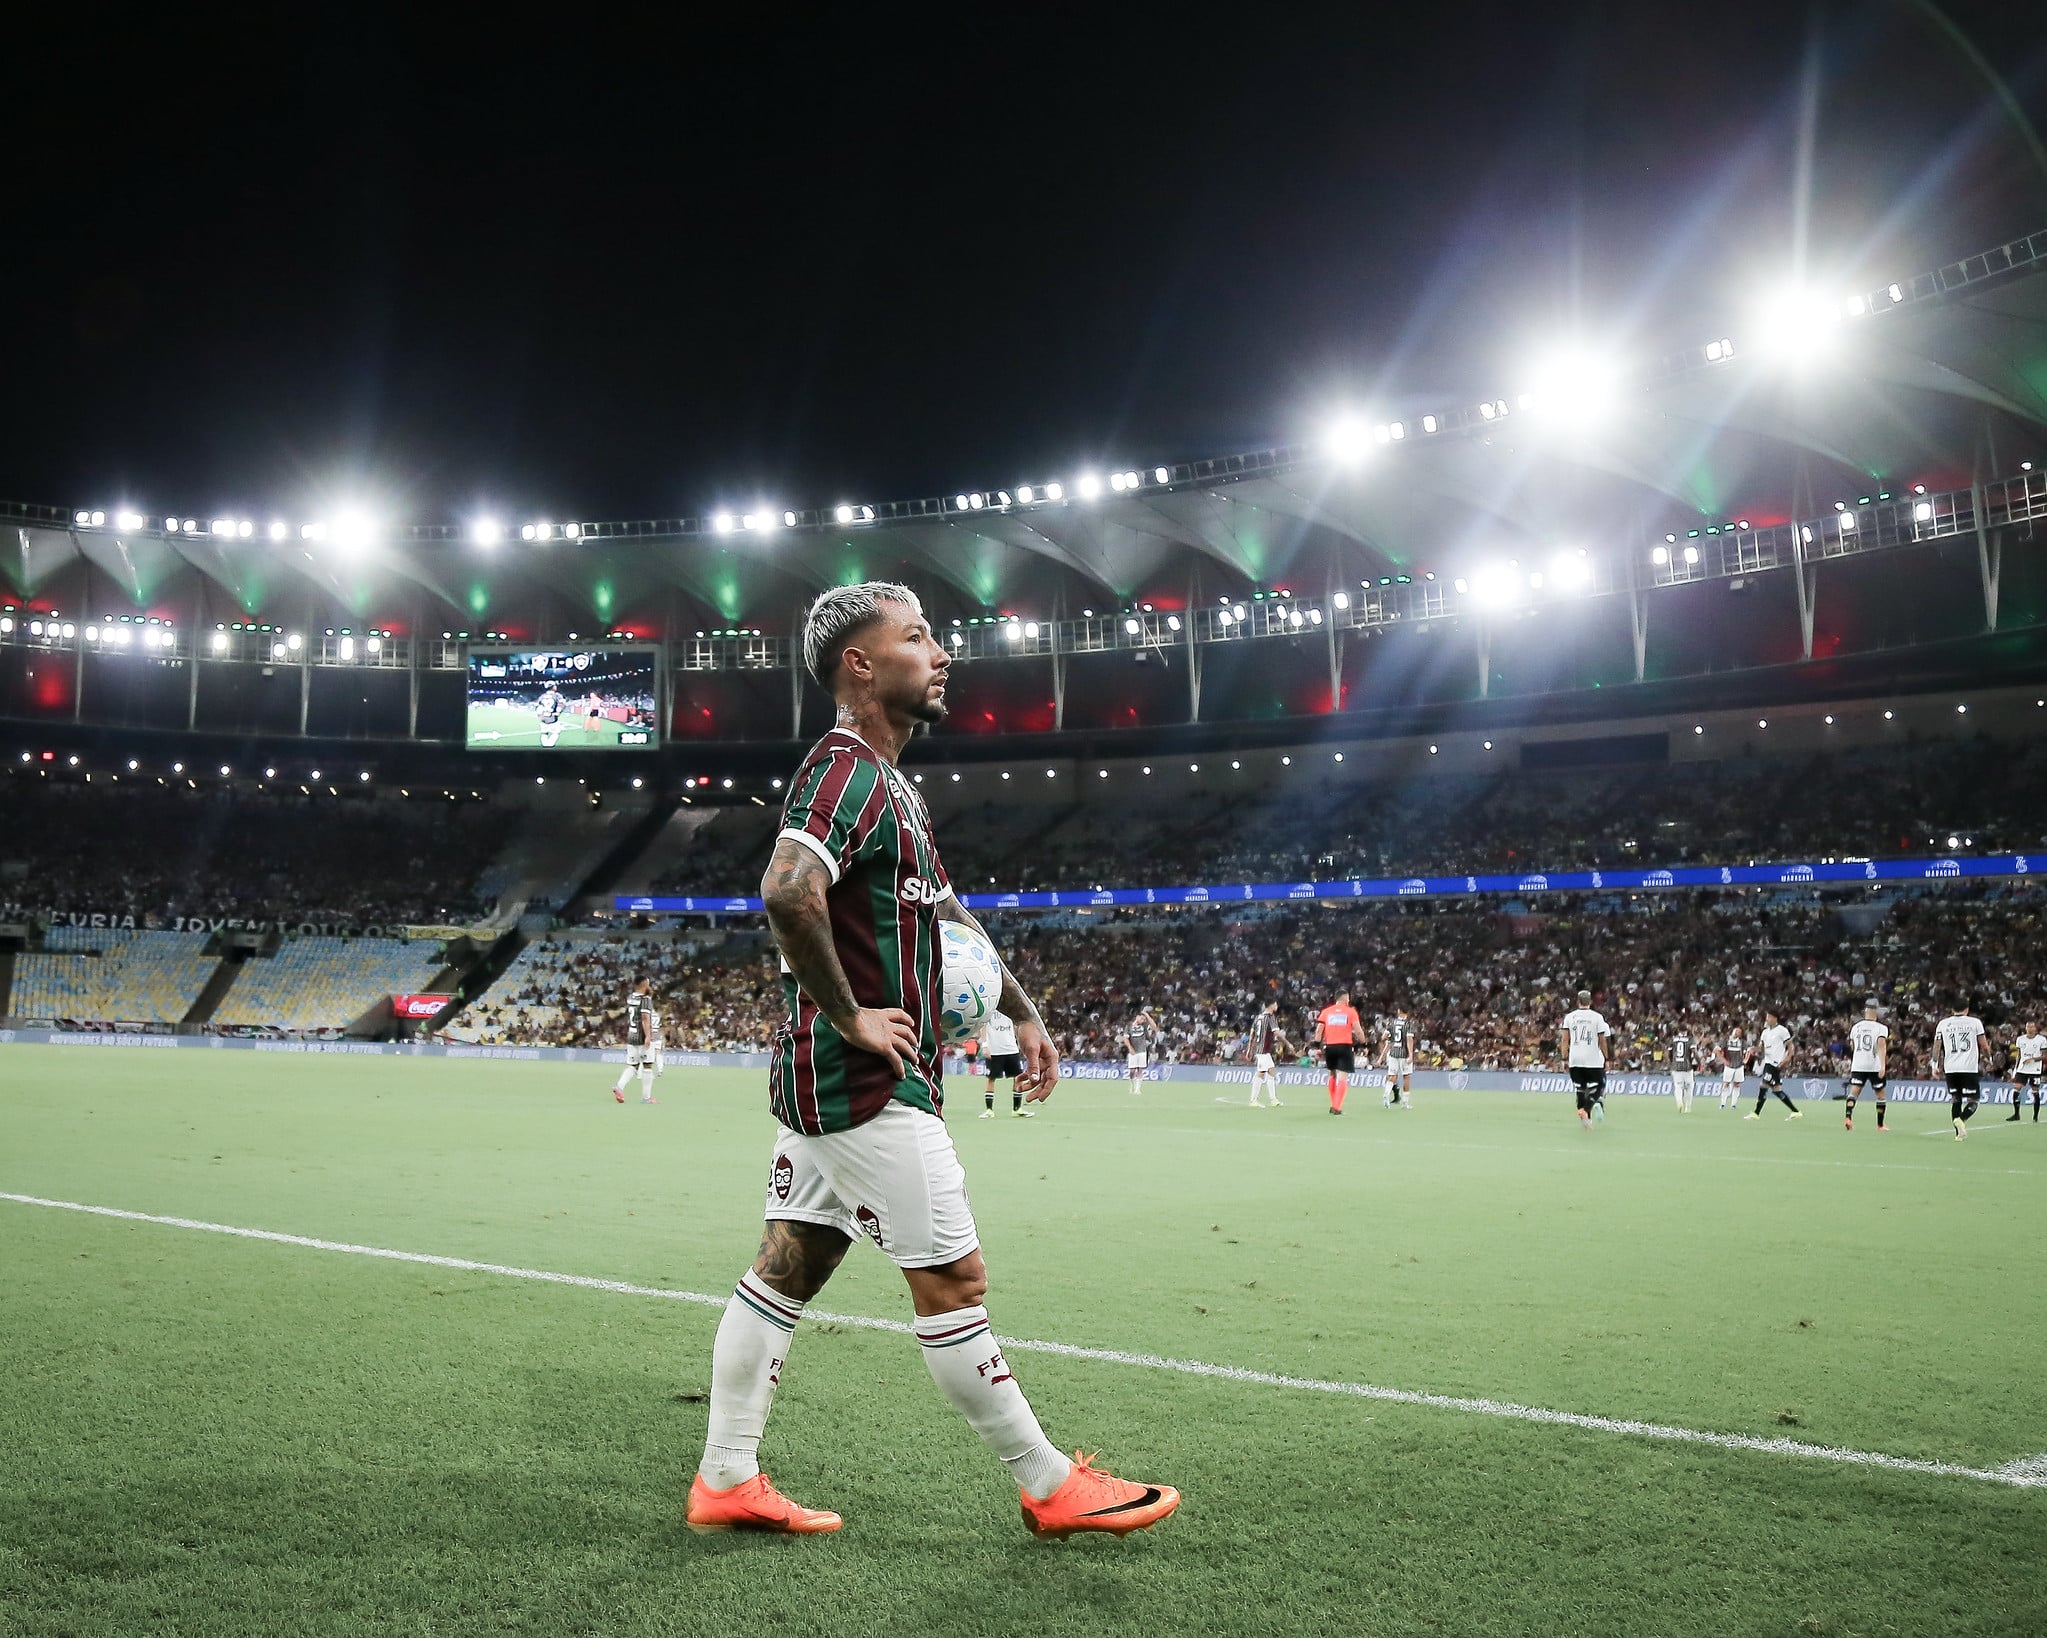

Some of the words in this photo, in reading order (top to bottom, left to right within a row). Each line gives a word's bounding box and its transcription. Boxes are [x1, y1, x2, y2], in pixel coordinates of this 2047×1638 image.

[900, 876, 936, 905] SU
[1394, 1025, 1402, 1042] 5
[1573, 1025, 1593, 1046] 14
[1856, 1033, 1873, 1052] 19
[1949, 1031, 1971, 1053] 13
[1676, 1041, 1685, 1057] 9
[1076, 1066, 1120, 1080] Betano
[1122, 1068, 1159, 1080] 226
[1284, 1072, 1302, 1085] NO
[1605, 1079, 1626, 1095] NO
[1629, 1076, 1672, 1095] SÓCIO
[976, 1353, 1004, 1377] FF
